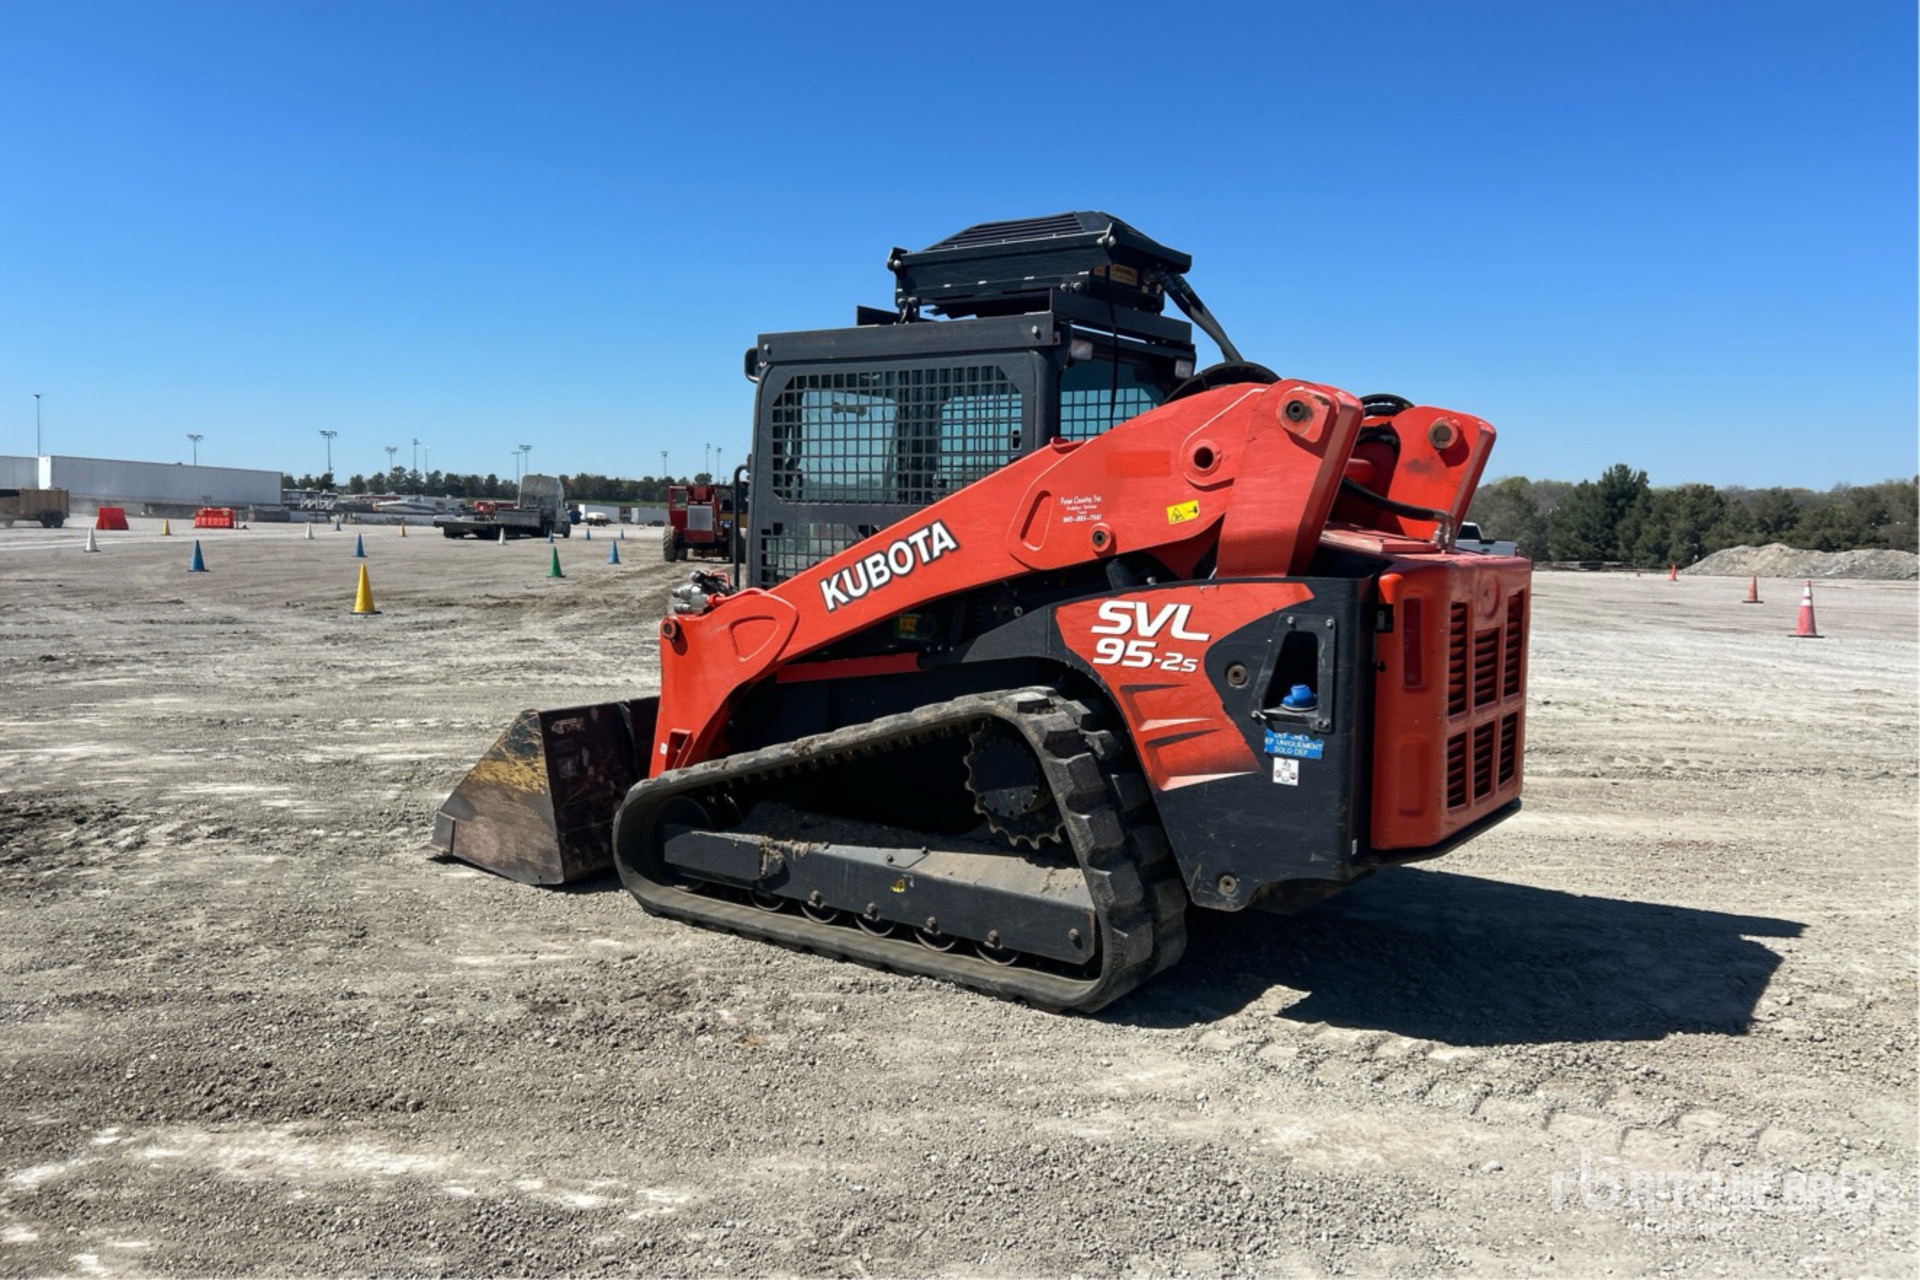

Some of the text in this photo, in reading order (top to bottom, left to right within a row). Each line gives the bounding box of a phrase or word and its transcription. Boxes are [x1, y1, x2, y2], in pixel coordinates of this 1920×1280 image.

[820, 521, 958, 611] KUBOTA
[1091, 600, 1211, 641] SVL
[1274, 745, 1308, 756] SOLO DEF
[1276, 739, 1323, 750] UNIQUEMENT
